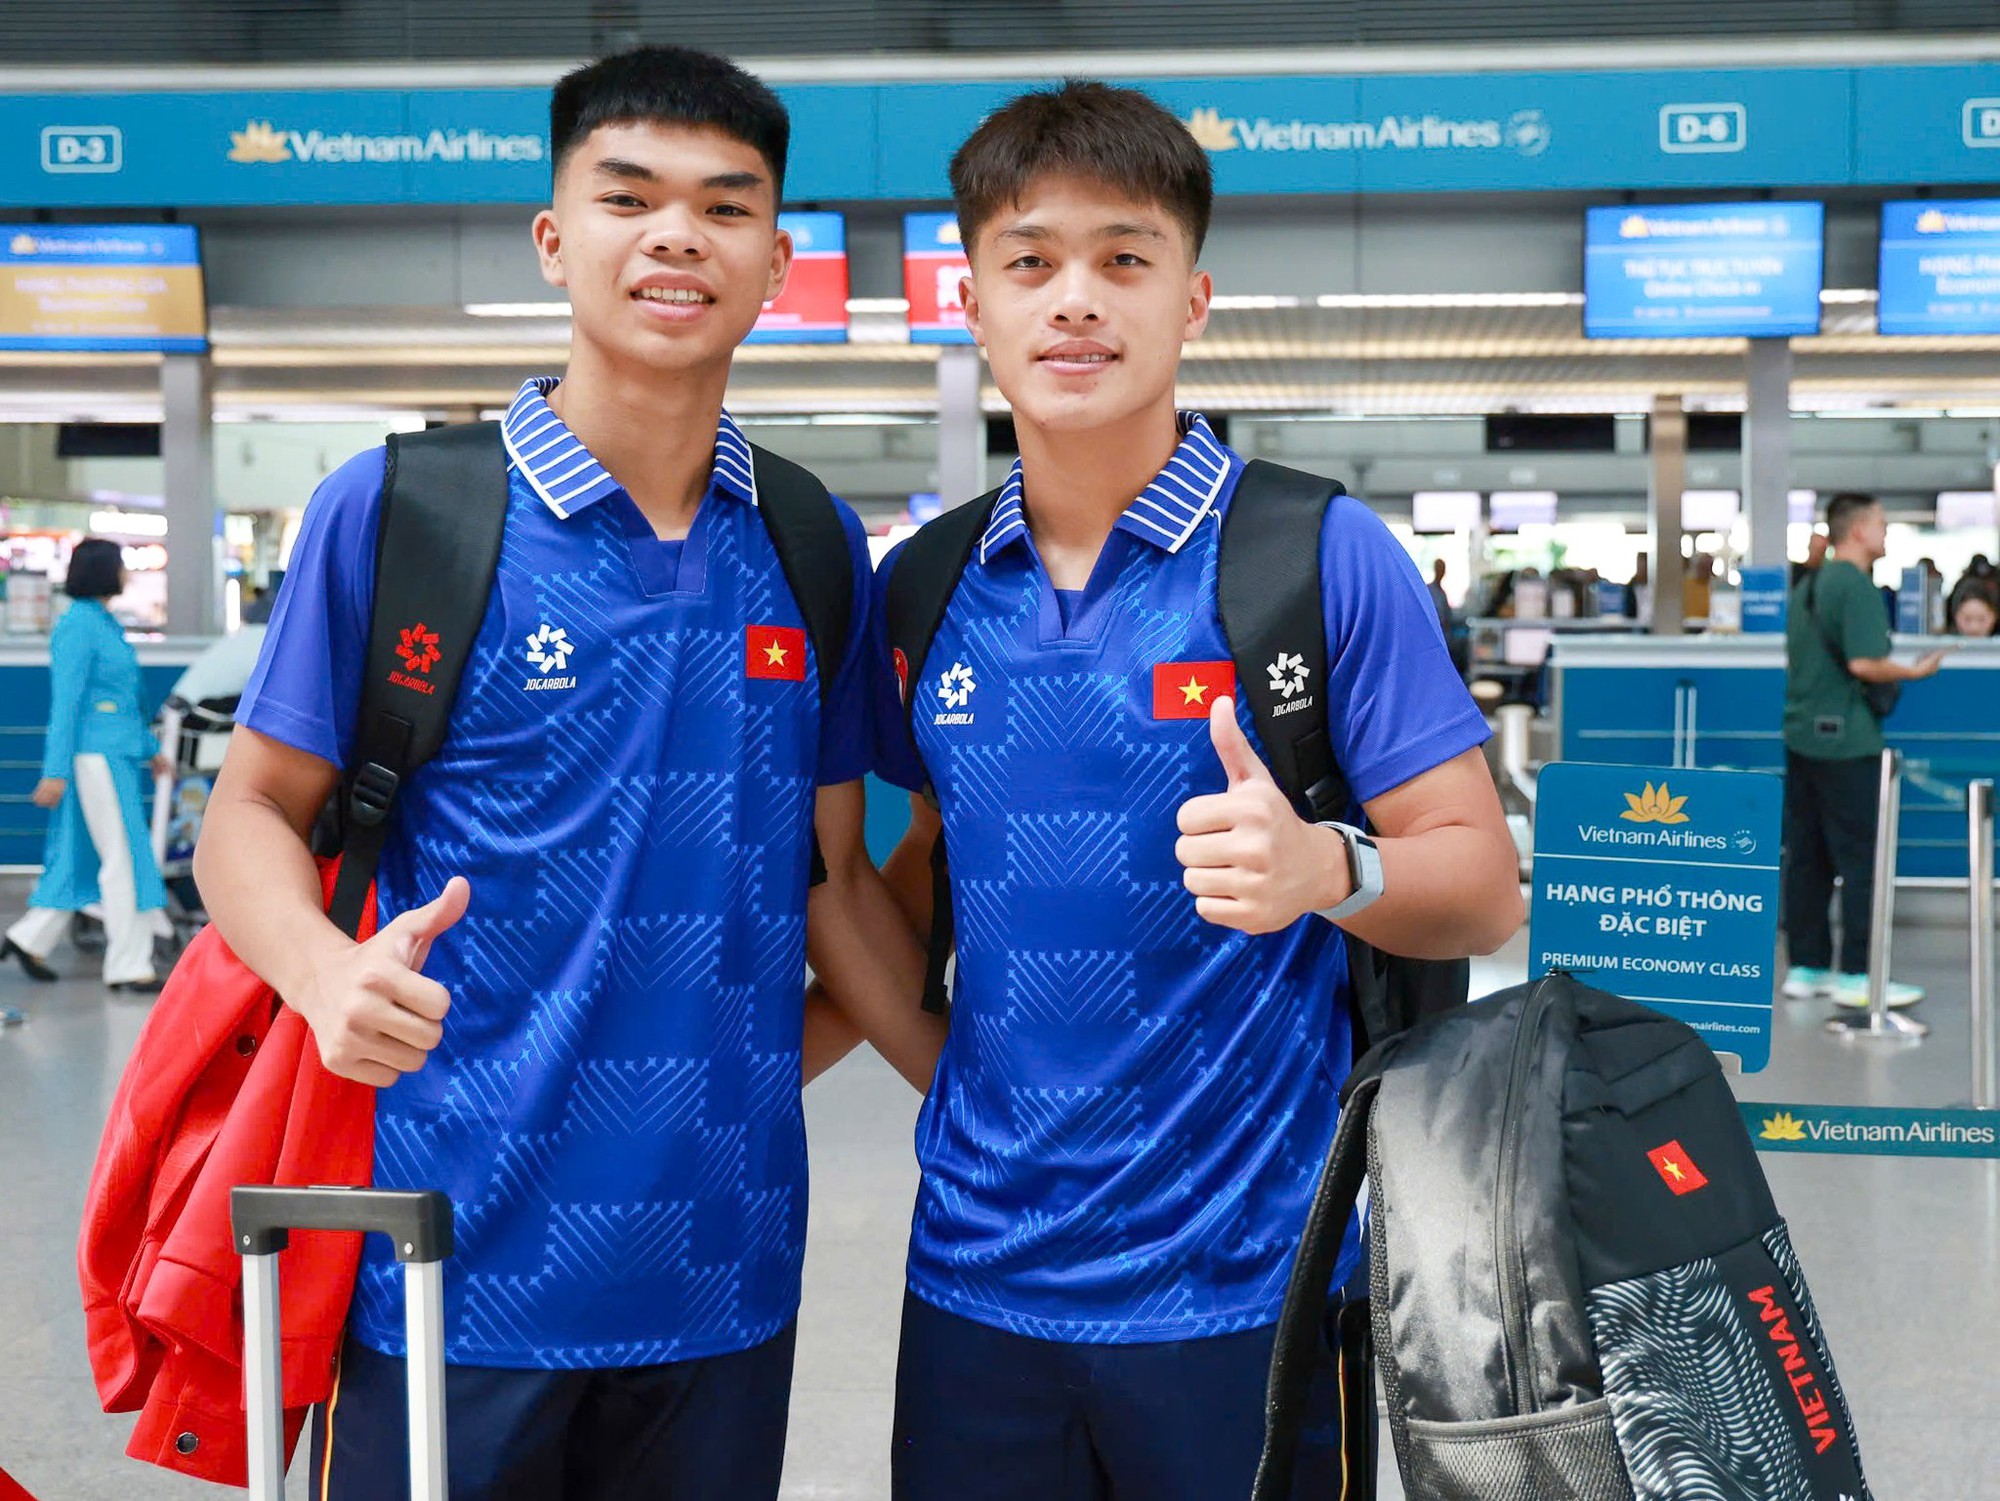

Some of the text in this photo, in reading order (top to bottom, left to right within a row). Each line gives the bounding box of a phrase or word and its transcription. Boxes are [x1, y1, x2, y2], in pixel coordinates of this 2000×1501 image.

[1236, 115, 1500, 150] Vietnam Airlines
[1677, 114, 1730, 143] D-6
[57, 136, 106, 163] D-3
[290, 128, 543, 162] Vietnam Airlines
[523, 676, 576, 691] JOGARBOLA
[933, 712, 974, 725] JOGARBOLA
[1272, 695, 1313, 717] JOGARBOLA
[1578, 825, 1727, 849] Vietnam Airlines
[1546, 883, 1763, 912] HẠNG PHỔ THÔNG
[1599, 912, 1707, 941] ĐẶC BIỆT
[1541, 952, 1761, 978] PREMIUM ECONOMY CLASS
[1807, 1120, 1995, 1143] Vietnam Airlines
[1747, 1285, 1837, 1455] VIETNAM
